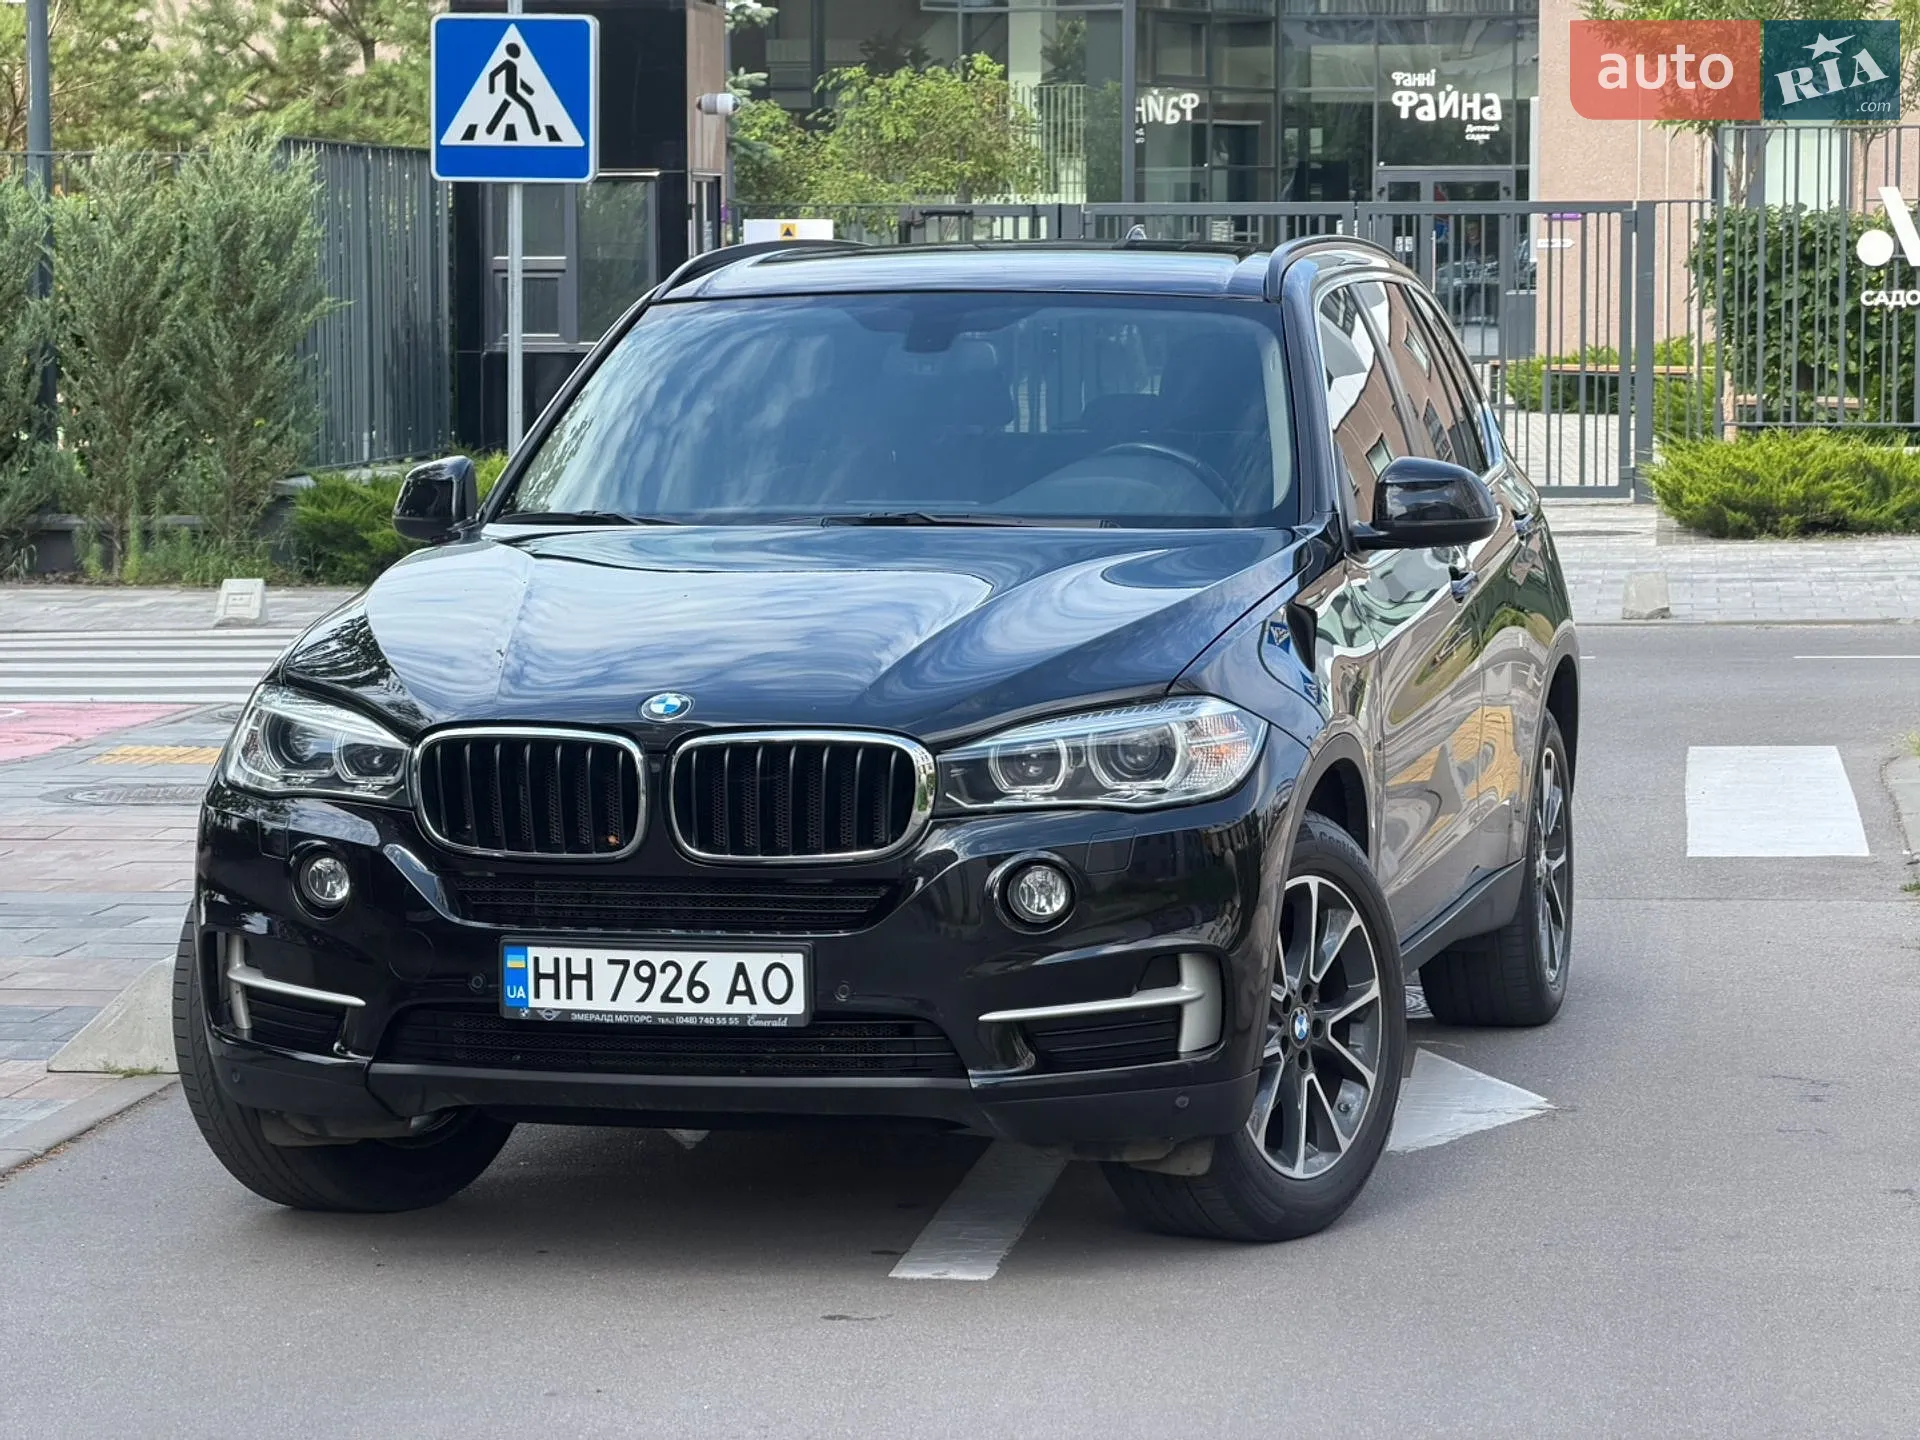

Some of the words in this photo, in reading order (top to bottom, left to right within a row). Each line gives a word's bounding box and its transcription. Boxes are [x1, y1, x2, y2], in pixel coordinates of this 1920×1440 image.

[1391, 84, 1502, 122] Файна
[506, 985, 526, 999] UA
[532, 956, 593, 1001] HH
[606, 958, 711, 1004] 7926
[726, 961, 794, 1006] AO
[570, 1012, 614, 1023] ЭМЕРАЛД
[614, 1014, 653, 1024] МОТОРС
